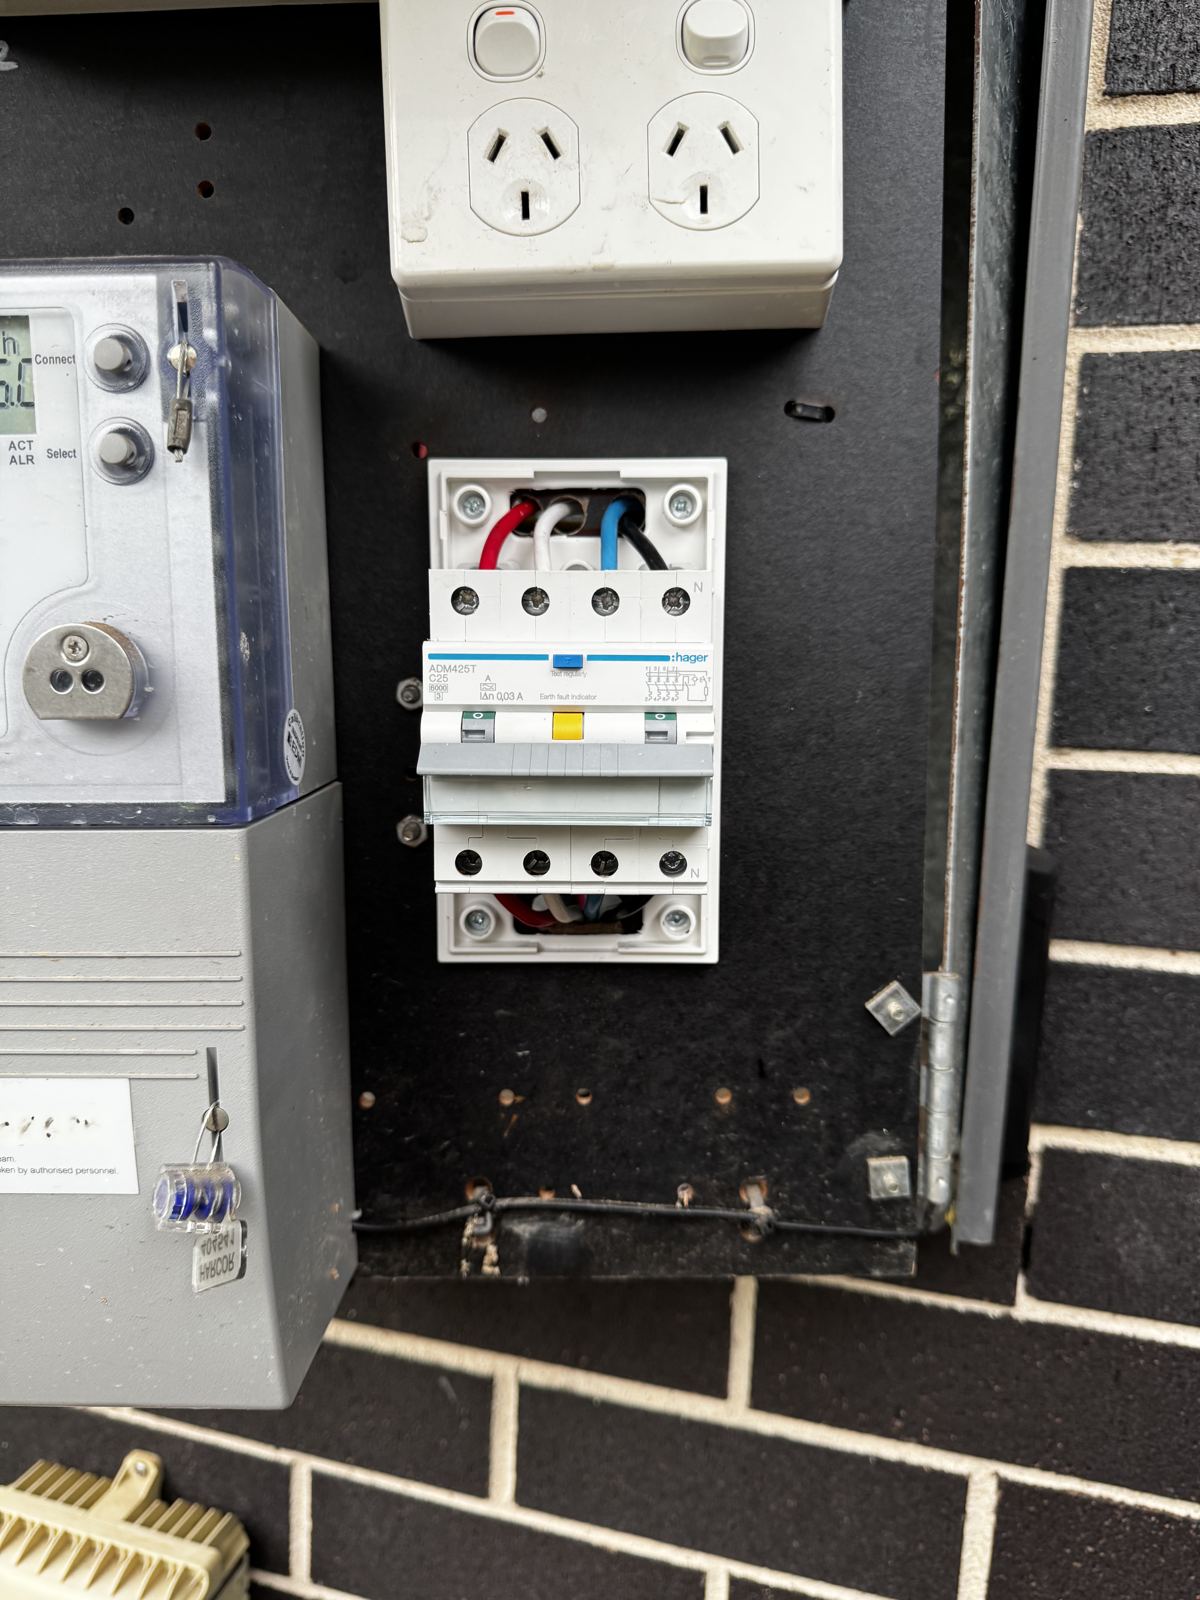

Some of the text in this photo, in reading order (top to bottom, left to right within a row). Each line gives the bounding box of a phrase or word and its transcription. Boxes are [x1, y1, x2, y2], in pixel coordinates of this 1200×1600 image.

[34, 354, 76, 365] Connect
[8, 440, 34, 450] ACT
[46, 449, 77, 458] Select
[9, 455, 35, 465] ALR
[693, 581, 703, 592] N
[428, 664, 477, 673] ADM425T
[428, 674, 449, 683] C25
[690, 868, 700, 878] N
[17, 1166, 28, 1175] by
[30, 1166, 74, 1174] authorised
